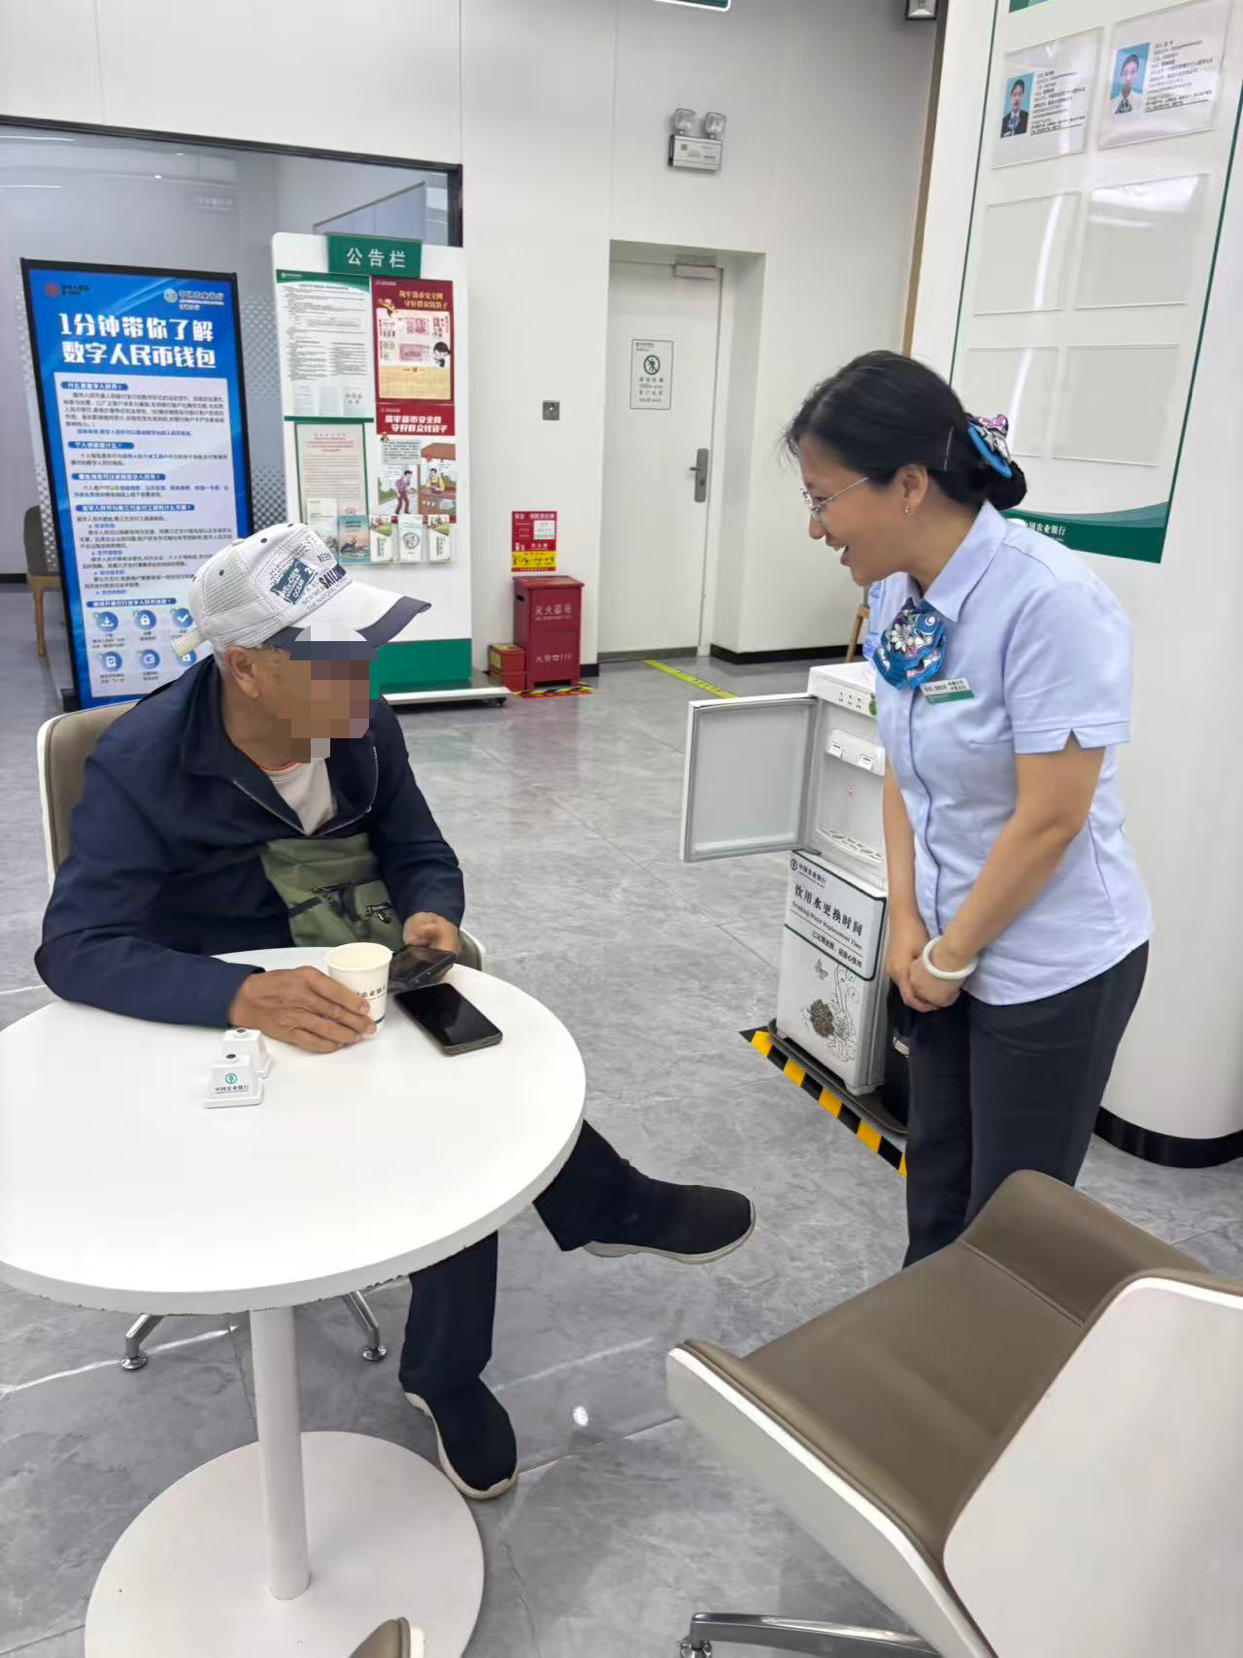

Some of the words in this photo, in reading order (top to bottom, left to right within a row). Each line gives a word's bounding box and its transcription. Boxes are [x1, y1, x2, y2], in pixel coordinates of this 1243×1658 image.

[346, 247, 406, 269] 公告栏
[58, 312, 214, 342] 1分钟带你了解
[61, 341, 217, 369] 数字人民币钱包
[794, 883, 863, 936] 饮用水更换时间
